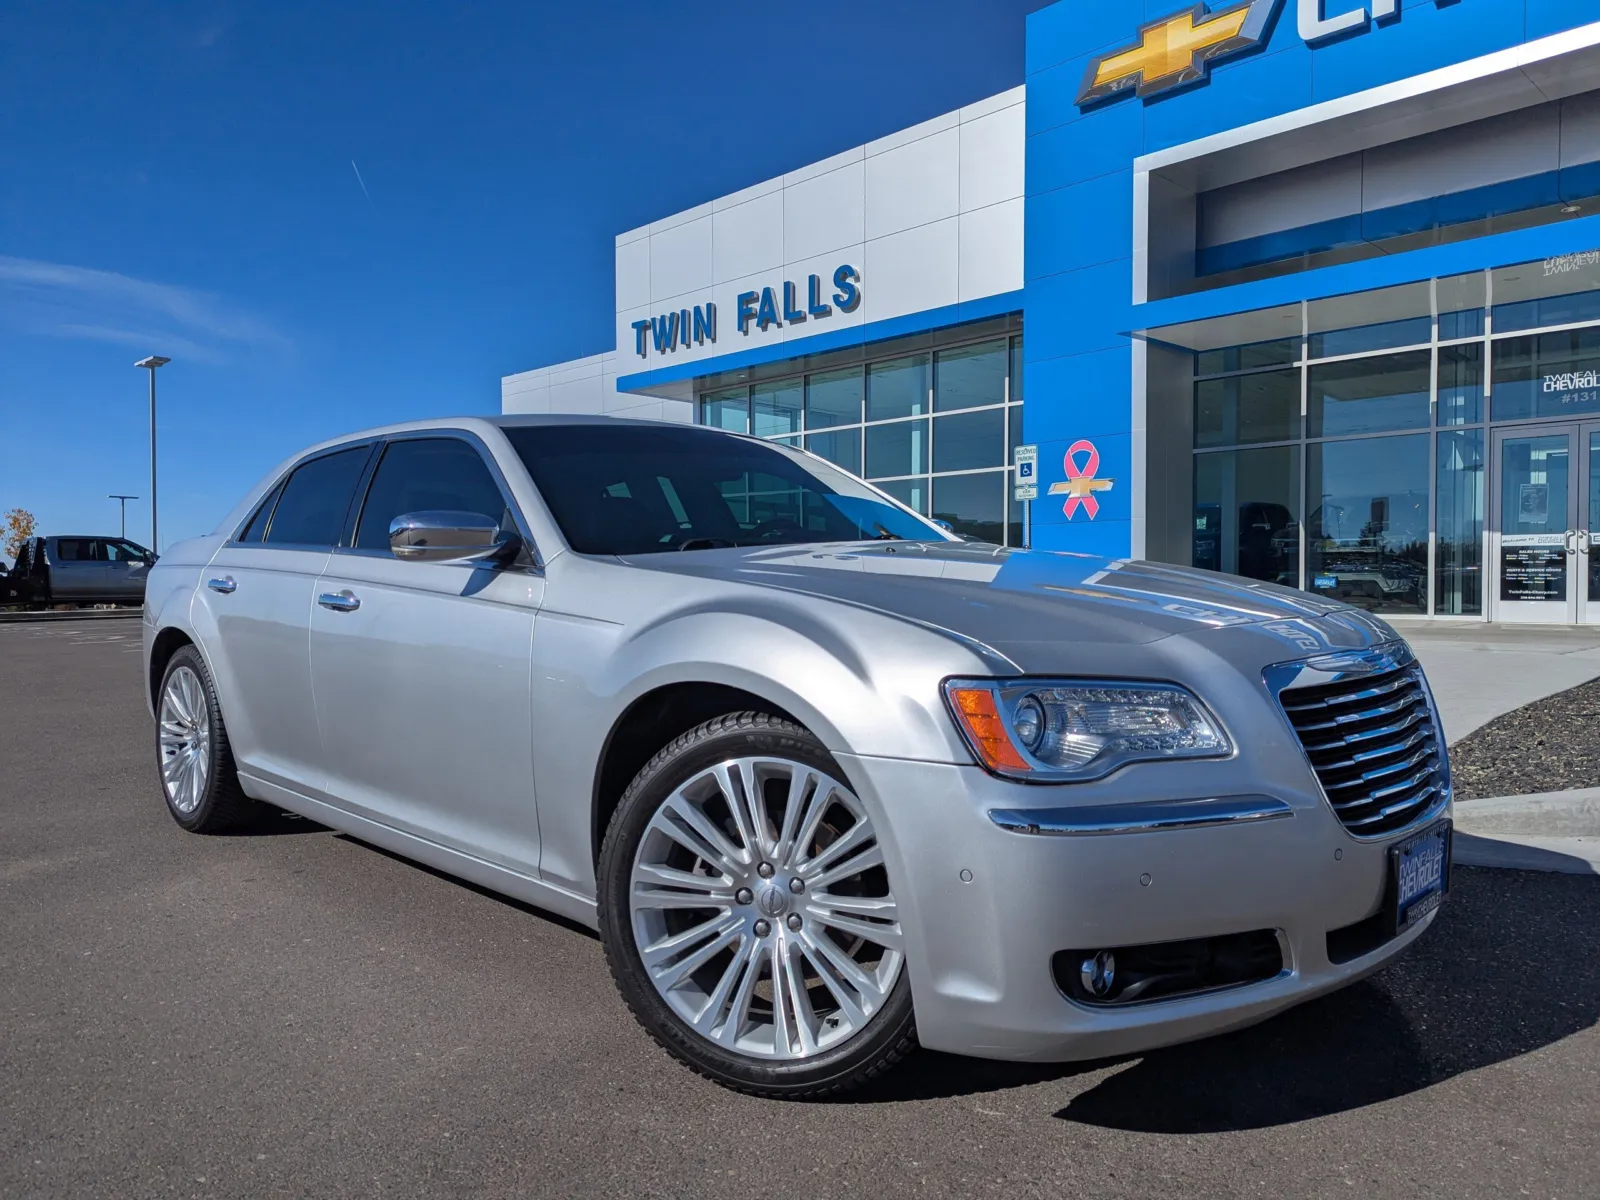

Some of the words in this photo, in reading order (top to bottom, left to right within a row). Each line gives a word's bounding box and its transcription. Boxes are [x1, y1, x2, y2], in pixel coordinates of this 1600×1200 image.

[631, 302, 716, 359] TWIN
[737, 264, 861, 336] FALLS
[1017, 454, 1035, 462] PARKING
[1399, 853, 1443, 904] CHEVROLET
[1400, 839, 1444, 877] TWINFALLS
